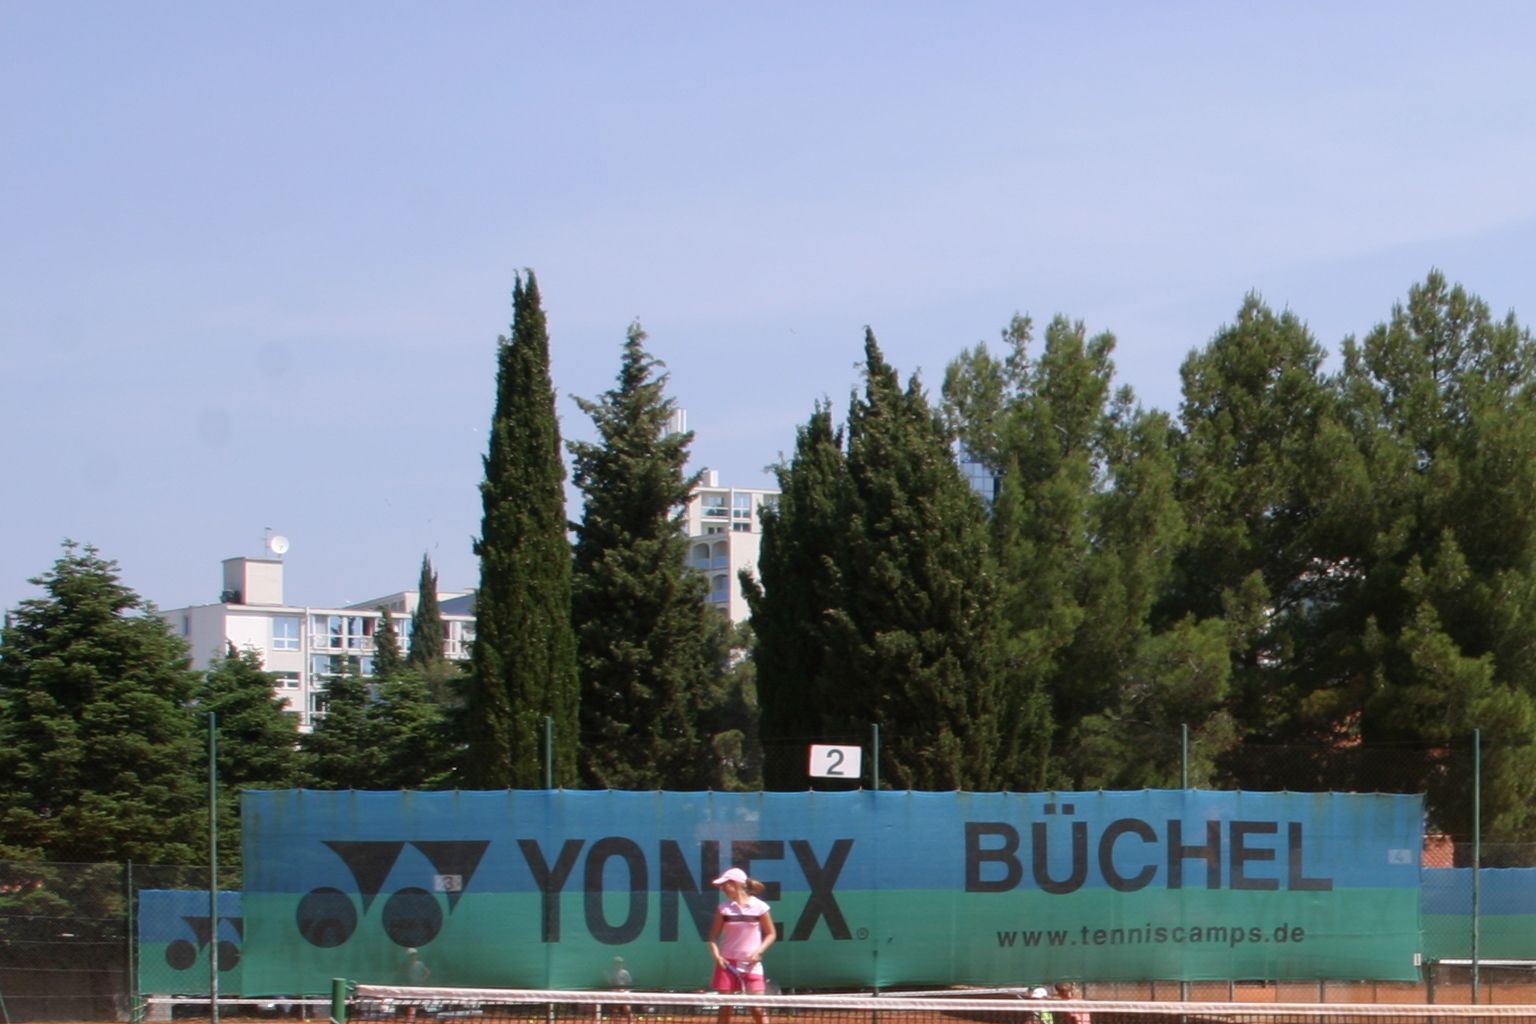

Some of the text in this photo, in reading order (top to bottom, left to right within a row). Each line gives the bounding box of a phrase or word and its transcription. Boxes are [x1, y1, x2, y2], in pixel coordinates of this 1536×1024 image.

[826, 748, 845, 776] 2
[964, 803, 1333, 895] BÜCHEL
[516, 836, 855, 946] YONEX
[996, 922, 1306, 948] www.tenniscamps.de
